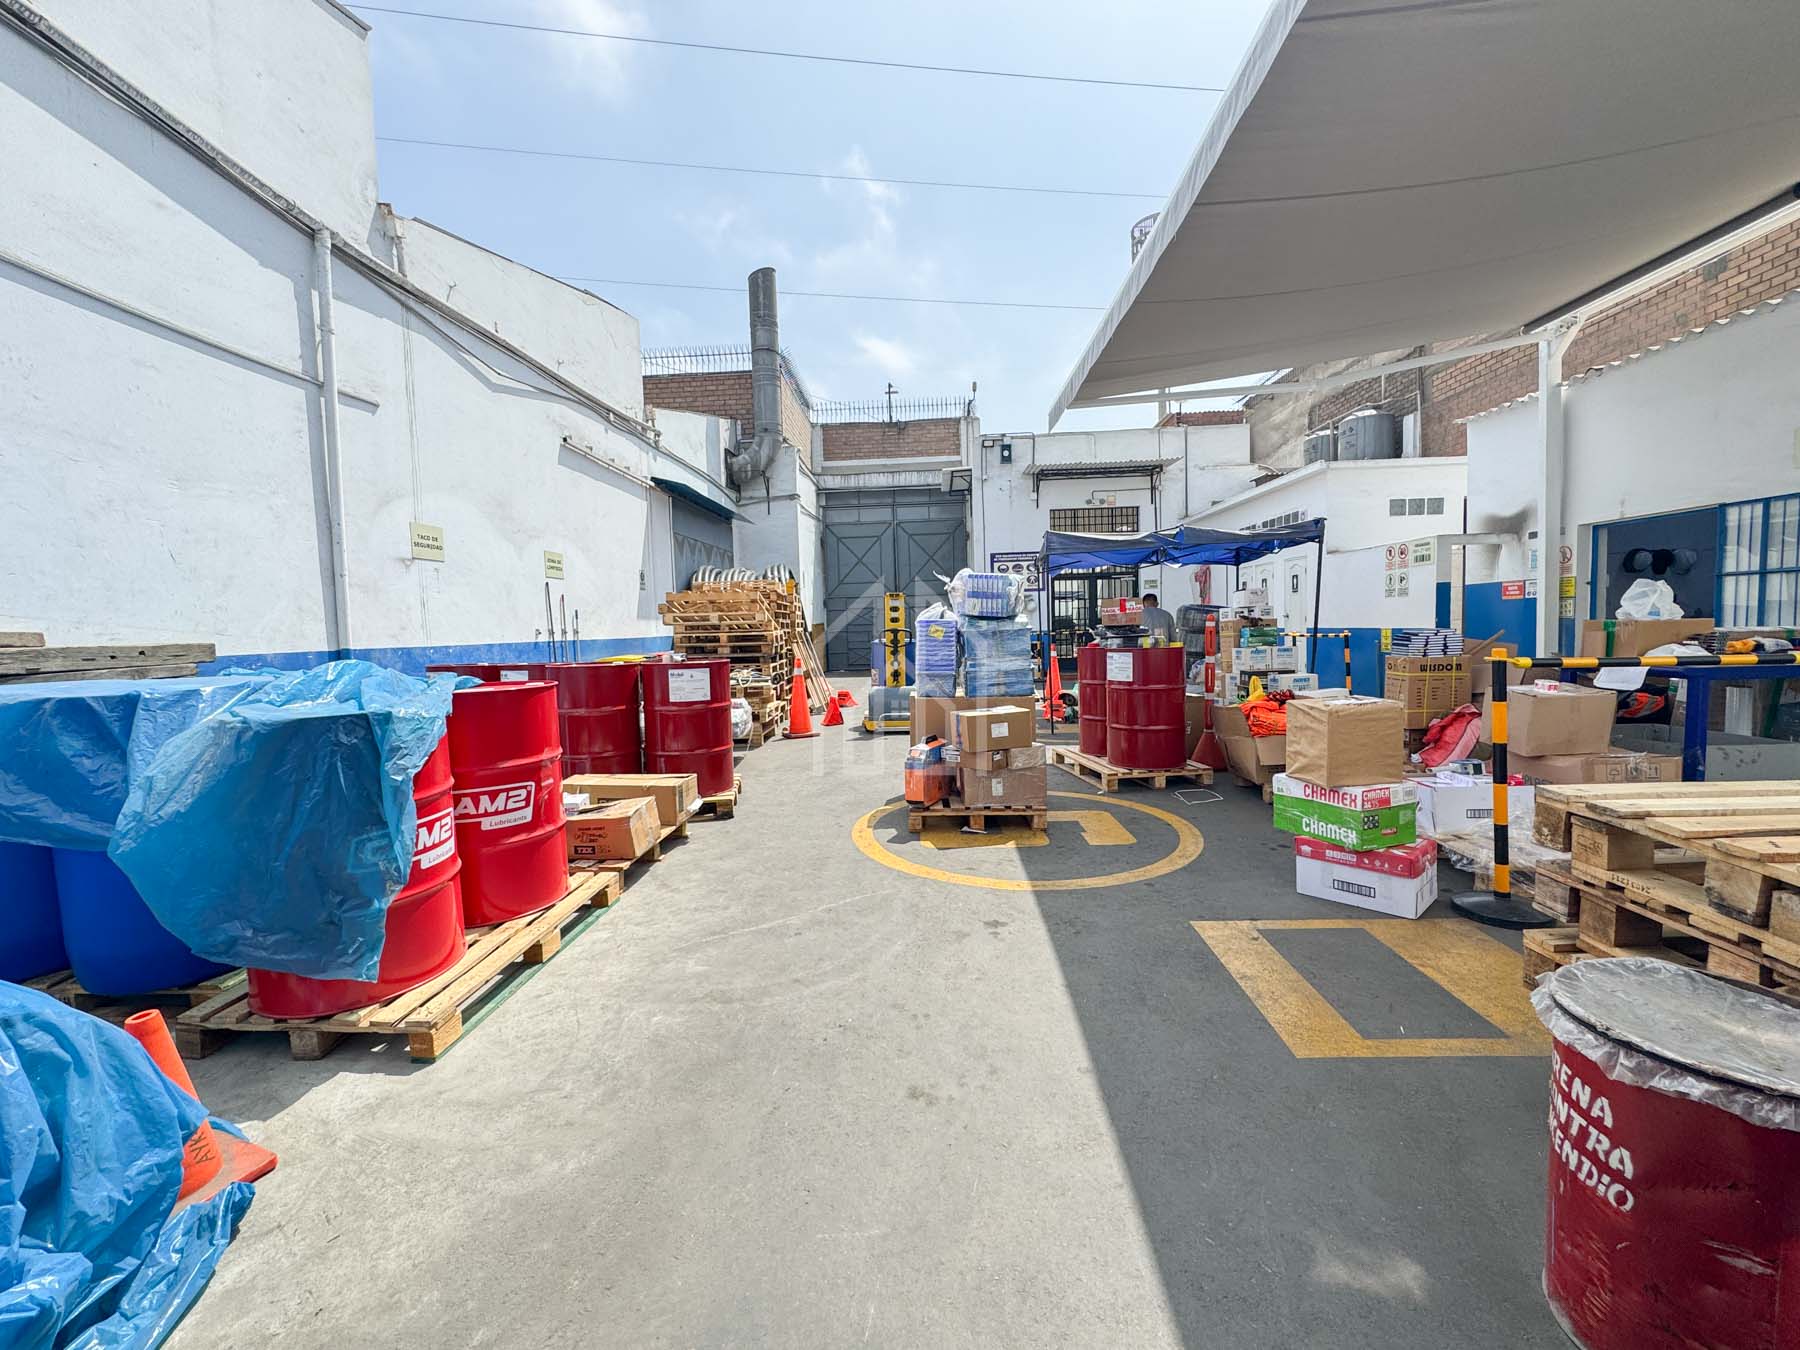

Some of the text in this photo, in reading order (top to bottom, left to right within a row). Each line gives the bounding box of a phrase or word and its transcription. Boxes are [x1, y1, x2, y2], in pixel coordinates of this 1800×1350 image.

[413, 541, 443, 551] SEGURIDAD
[416, 533, 431, 542] TACO
[1420, 663, 1462, 672] WISDOM
[454, 788, 528, 817] AM2
[1303, 783, 1358, 808] CHAMEX
[1363, 788, 1390, 801] CHAMEX
[415, 815, 453, 851] M2
[489, 815, 528, 828] Lubricants
[1302, 817, 1357, 845] CHAMEX
[1551, 1049, 1613, 1129] RENA
[1551, 1081, 1634, 1181] ONTRA
